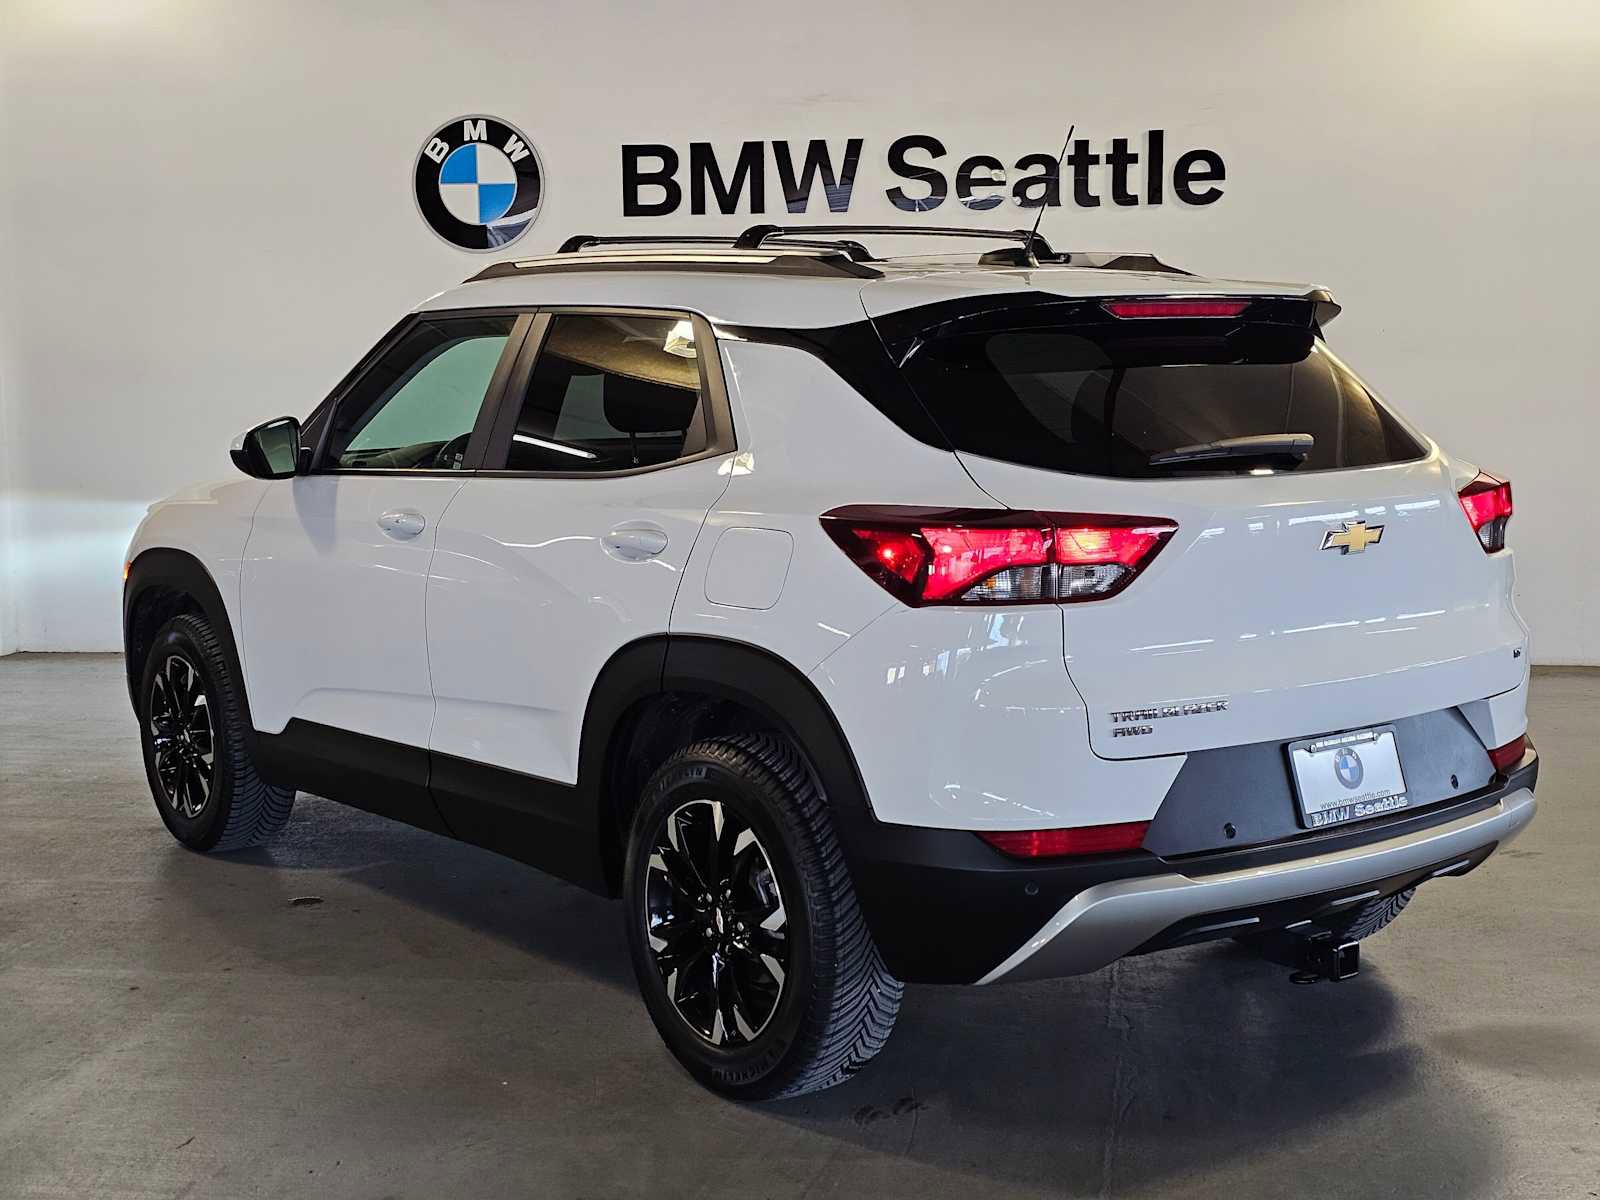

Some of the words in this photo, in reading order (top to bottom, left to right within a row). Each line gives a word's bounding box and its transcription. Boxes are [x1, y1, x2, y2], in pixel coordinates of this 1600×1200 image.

[424, 119, 530, 164] BMW
[622, 138, 864, 217] BMW
[885, 129, 1226, 212] Seattle
[1112, 725, 1153, 737] AWD
[1311, 806, 1350, 826] BMW
[1354, 796, 1408, 817] Seattle
